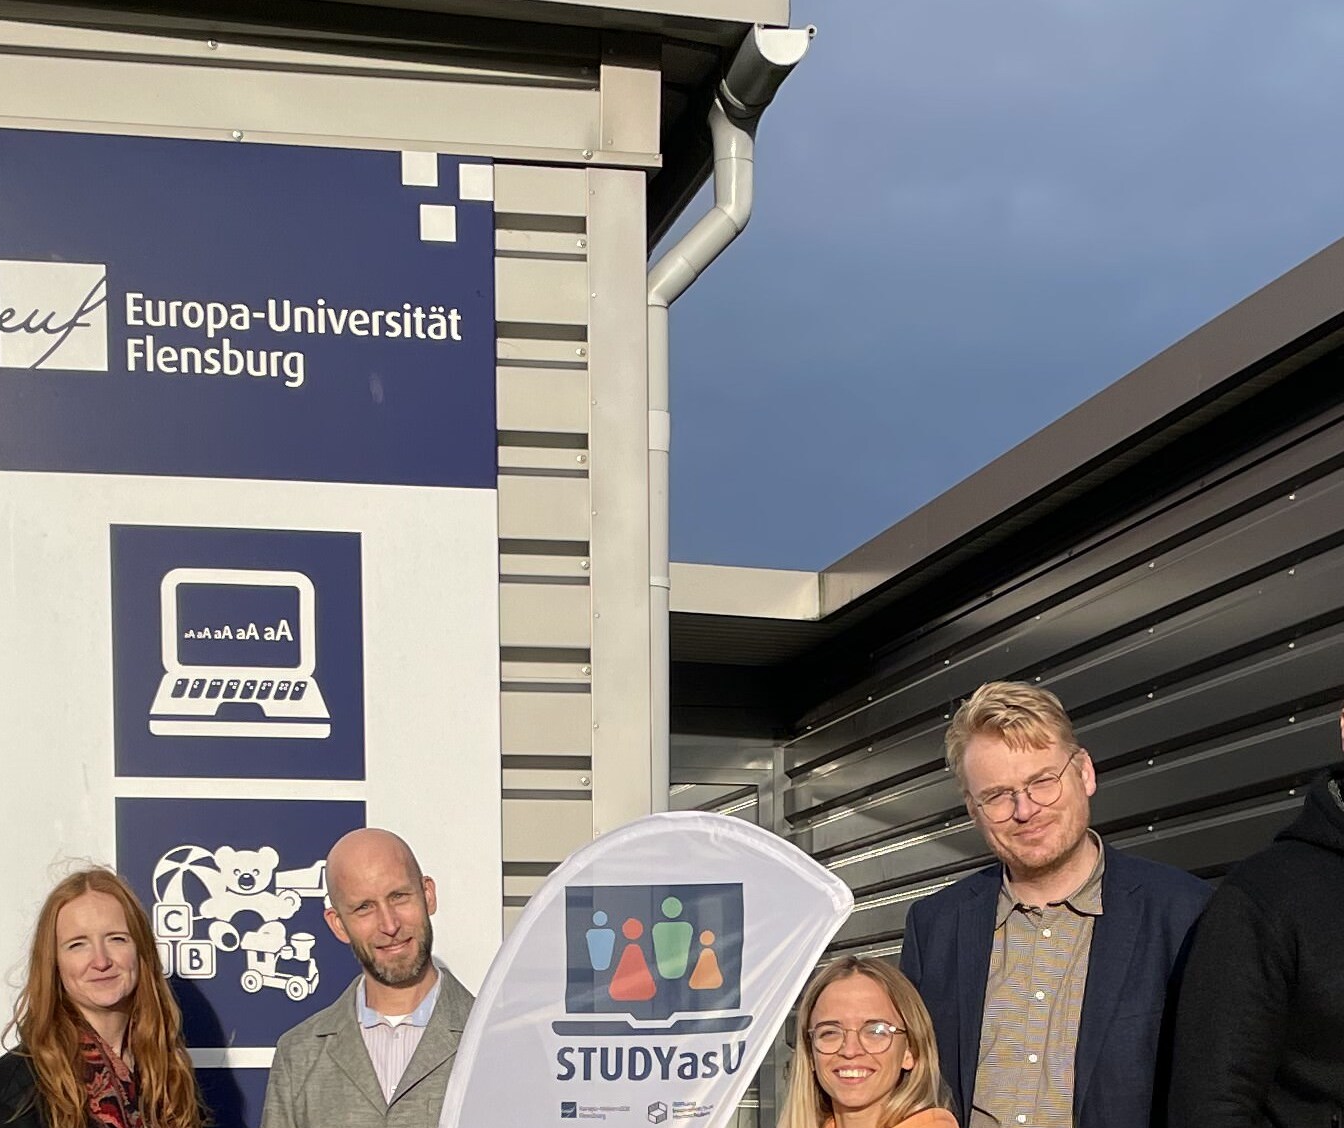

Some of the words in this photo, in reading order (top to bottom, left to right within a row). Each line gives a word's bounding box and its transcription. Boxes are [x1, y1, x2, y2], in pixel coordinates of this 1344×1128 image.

[126, 292, 462, 341] Europa-Universität
[127, 335, 305, 388] Flensburg
[214, 625, 233, 640] aA
[236, 622, 260, 640] aA
[263, 619, 294, 641] aA
[164, 910, 183, 932] C
[189, 948, 203, 971] B
[556, 1041, 746, 1081] STUDYasU
